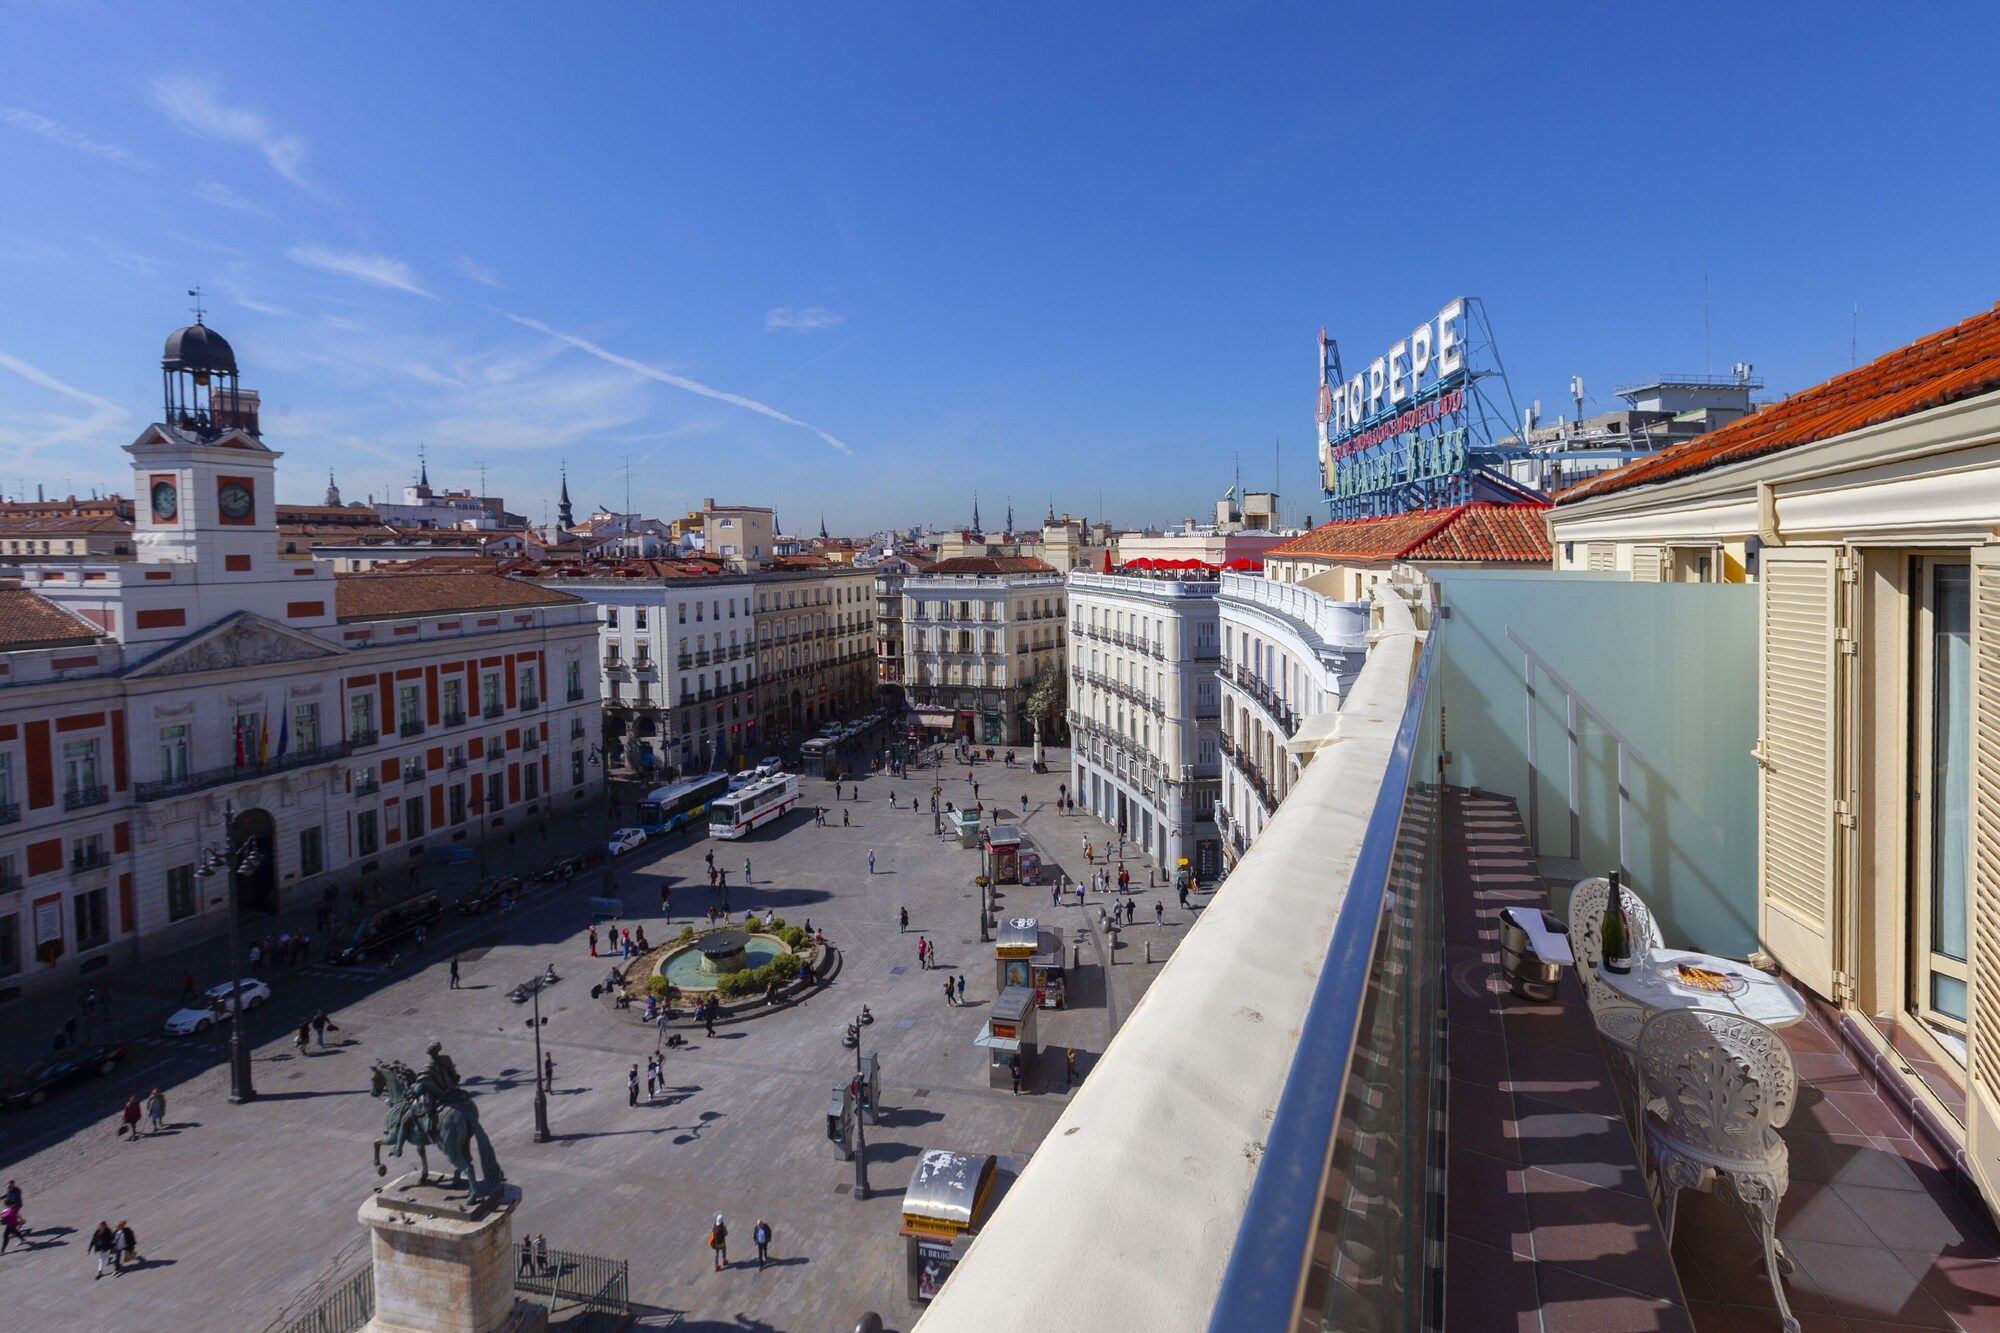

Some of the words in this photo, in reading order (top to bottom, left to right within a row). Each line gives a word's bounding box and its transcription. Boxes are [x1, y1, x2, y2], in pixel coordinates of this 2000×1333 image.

[1333, 372, 1364, 434] TIO
[1370, 296, 1465, 415] PEPE
[1406, 426, 1465, 483] BYASS
[920, 1248, 927, 1256] EL
[928, 1249, 950, 1261] BRUJO
